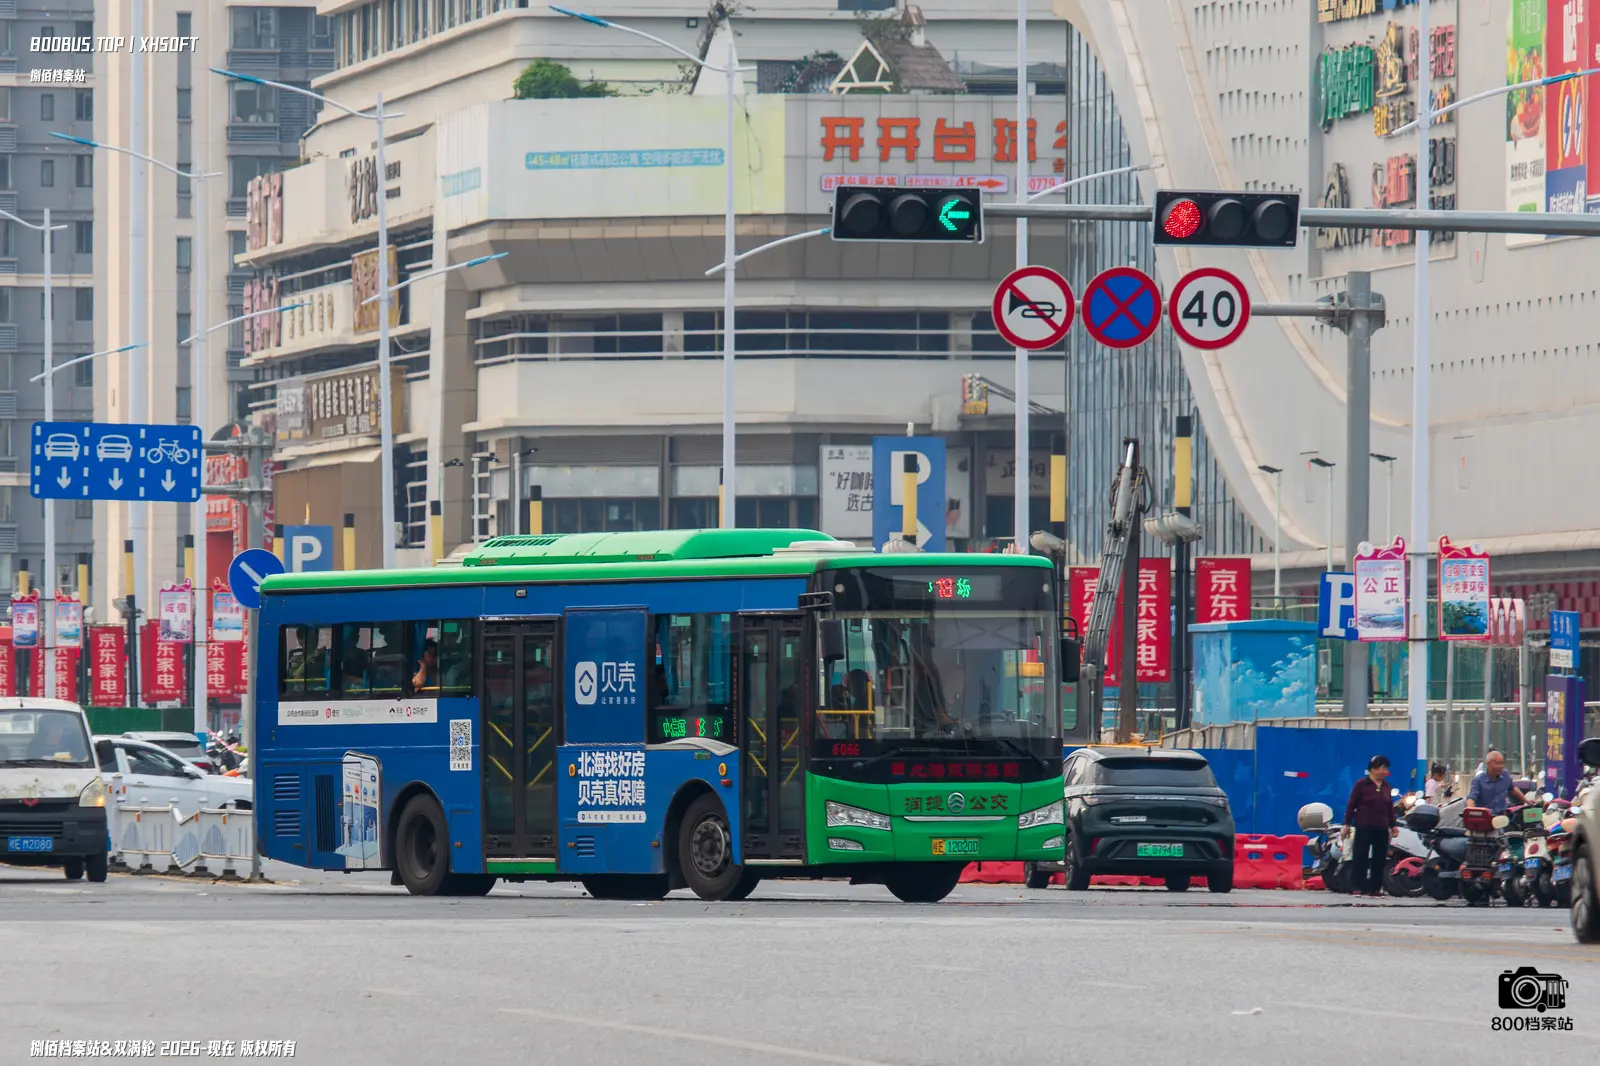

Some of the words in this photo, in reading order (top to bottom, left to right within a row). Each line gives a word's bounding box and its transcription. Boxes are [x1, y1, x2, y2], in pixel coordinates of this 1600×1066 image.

[1182, 290, 1236, 328] 40
[891, 451, 932, 505] P
[293, 535, 322, 571] P
[1363, 577, 1399, 594] 公正
[16, 612, 35, 624] 友善
[164, 602, 187, 614] 诚信
[98, 633, 117, 694] 京东家电
[602, 661, 636, 693] 贝壳
[578, 751, 645, 777] 北海找好房
[578, 779, 645, 806] 贝壳真保障
